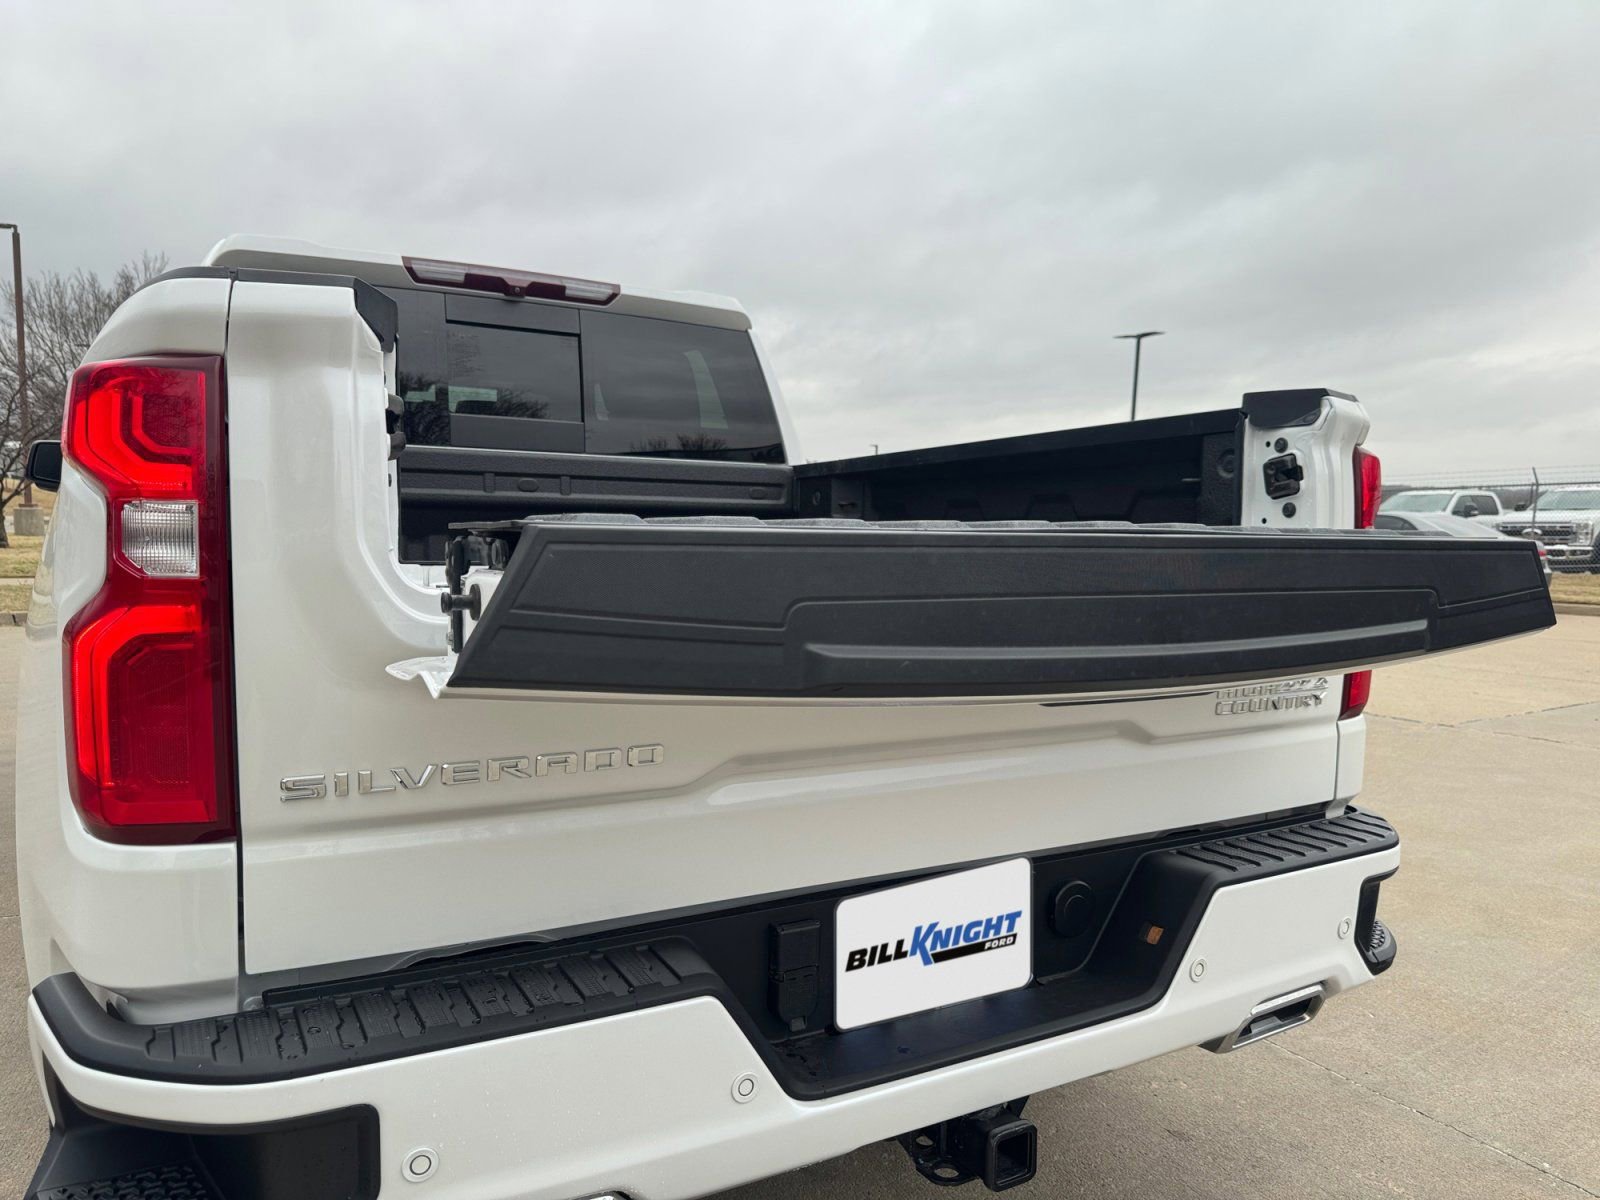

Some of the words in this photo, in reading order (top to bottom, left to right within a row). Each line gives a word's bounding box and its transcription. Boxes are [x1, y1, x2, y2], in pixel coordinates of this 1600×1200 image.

[1215, 691, 1328, 716] COUNTRY
[280, 743, 665, 803] SILVERADO
[984, 936, 1014, 950] FORD
